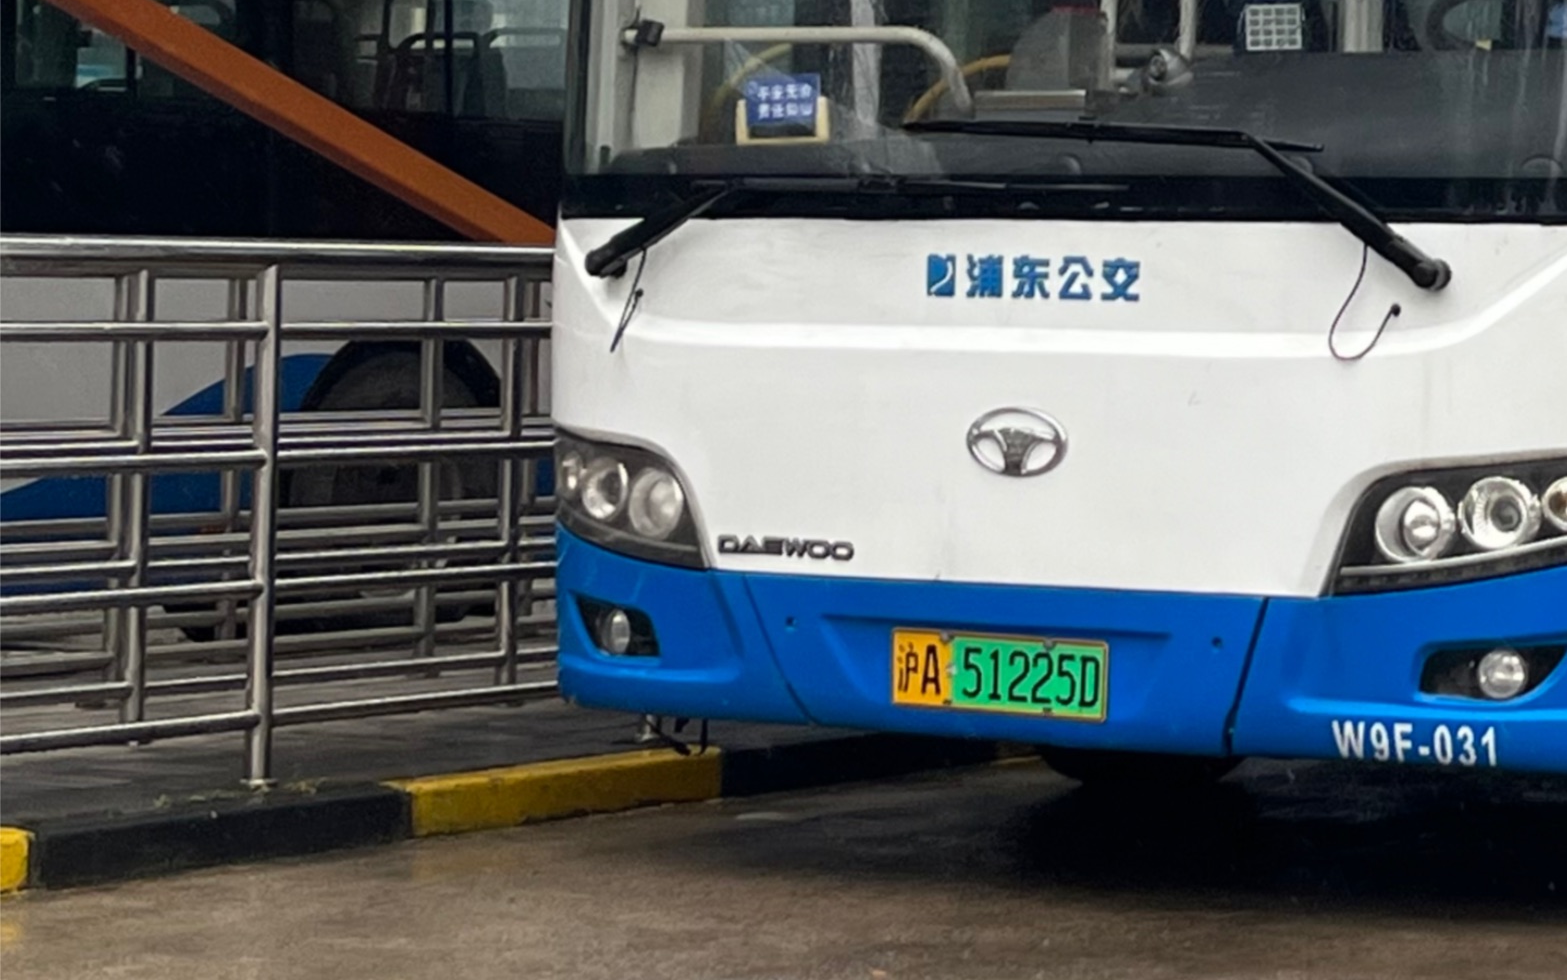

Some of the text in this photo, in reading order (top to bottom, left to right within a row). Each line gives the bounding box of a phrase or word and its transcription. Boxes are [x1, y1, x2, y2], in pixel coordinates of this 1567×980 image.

[966, 254, 1141, 302] 浦东公交
[718, 534, 854, 561] DAEWOO
[897, 641, 1101, 709] 沪A 51225D
[1332, 720, 1497, 767] W9F-031
